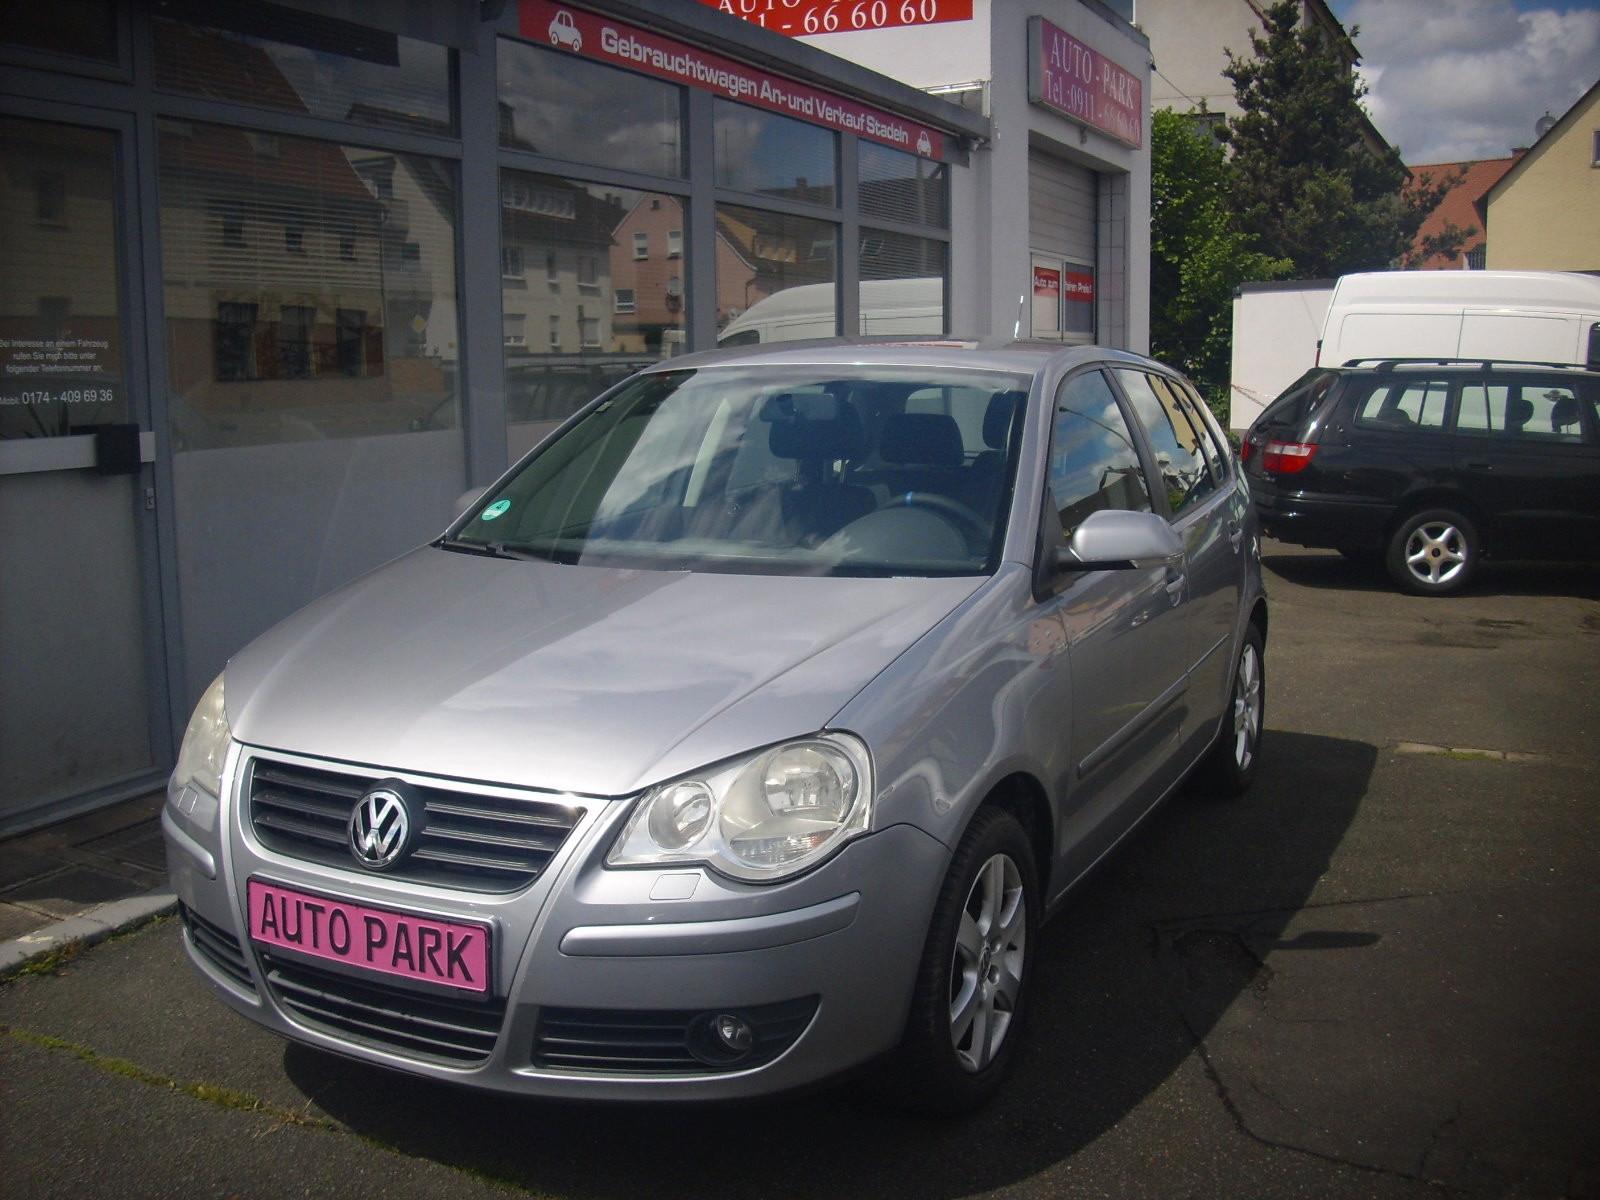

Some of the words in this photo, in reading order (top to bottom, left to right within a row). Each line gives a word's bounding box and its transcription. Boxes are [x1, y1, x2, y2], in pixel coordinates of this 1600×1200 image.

[804, 5, 839, 33] 66
[851, 1, 887, 29] 60
[900, 0, 936, 24] 60
[601, 27, 757, 96] Gebrauchtwagen
[787, 93, 813, 115] und
[815, 98, 865, 131] Verkauf
[1051, 32, 1092, 84] AUTO
[1103, 63, 1135, 110] PARK
[22, 391, 50, 405] 0174
[60, 389, 81, 403] 409
[84, 389, 97, 402] 69
[100, 388, 113, 401] 36
[261, 892, 351, 956] AUTO
[363, 915, 474, 983] PARK
